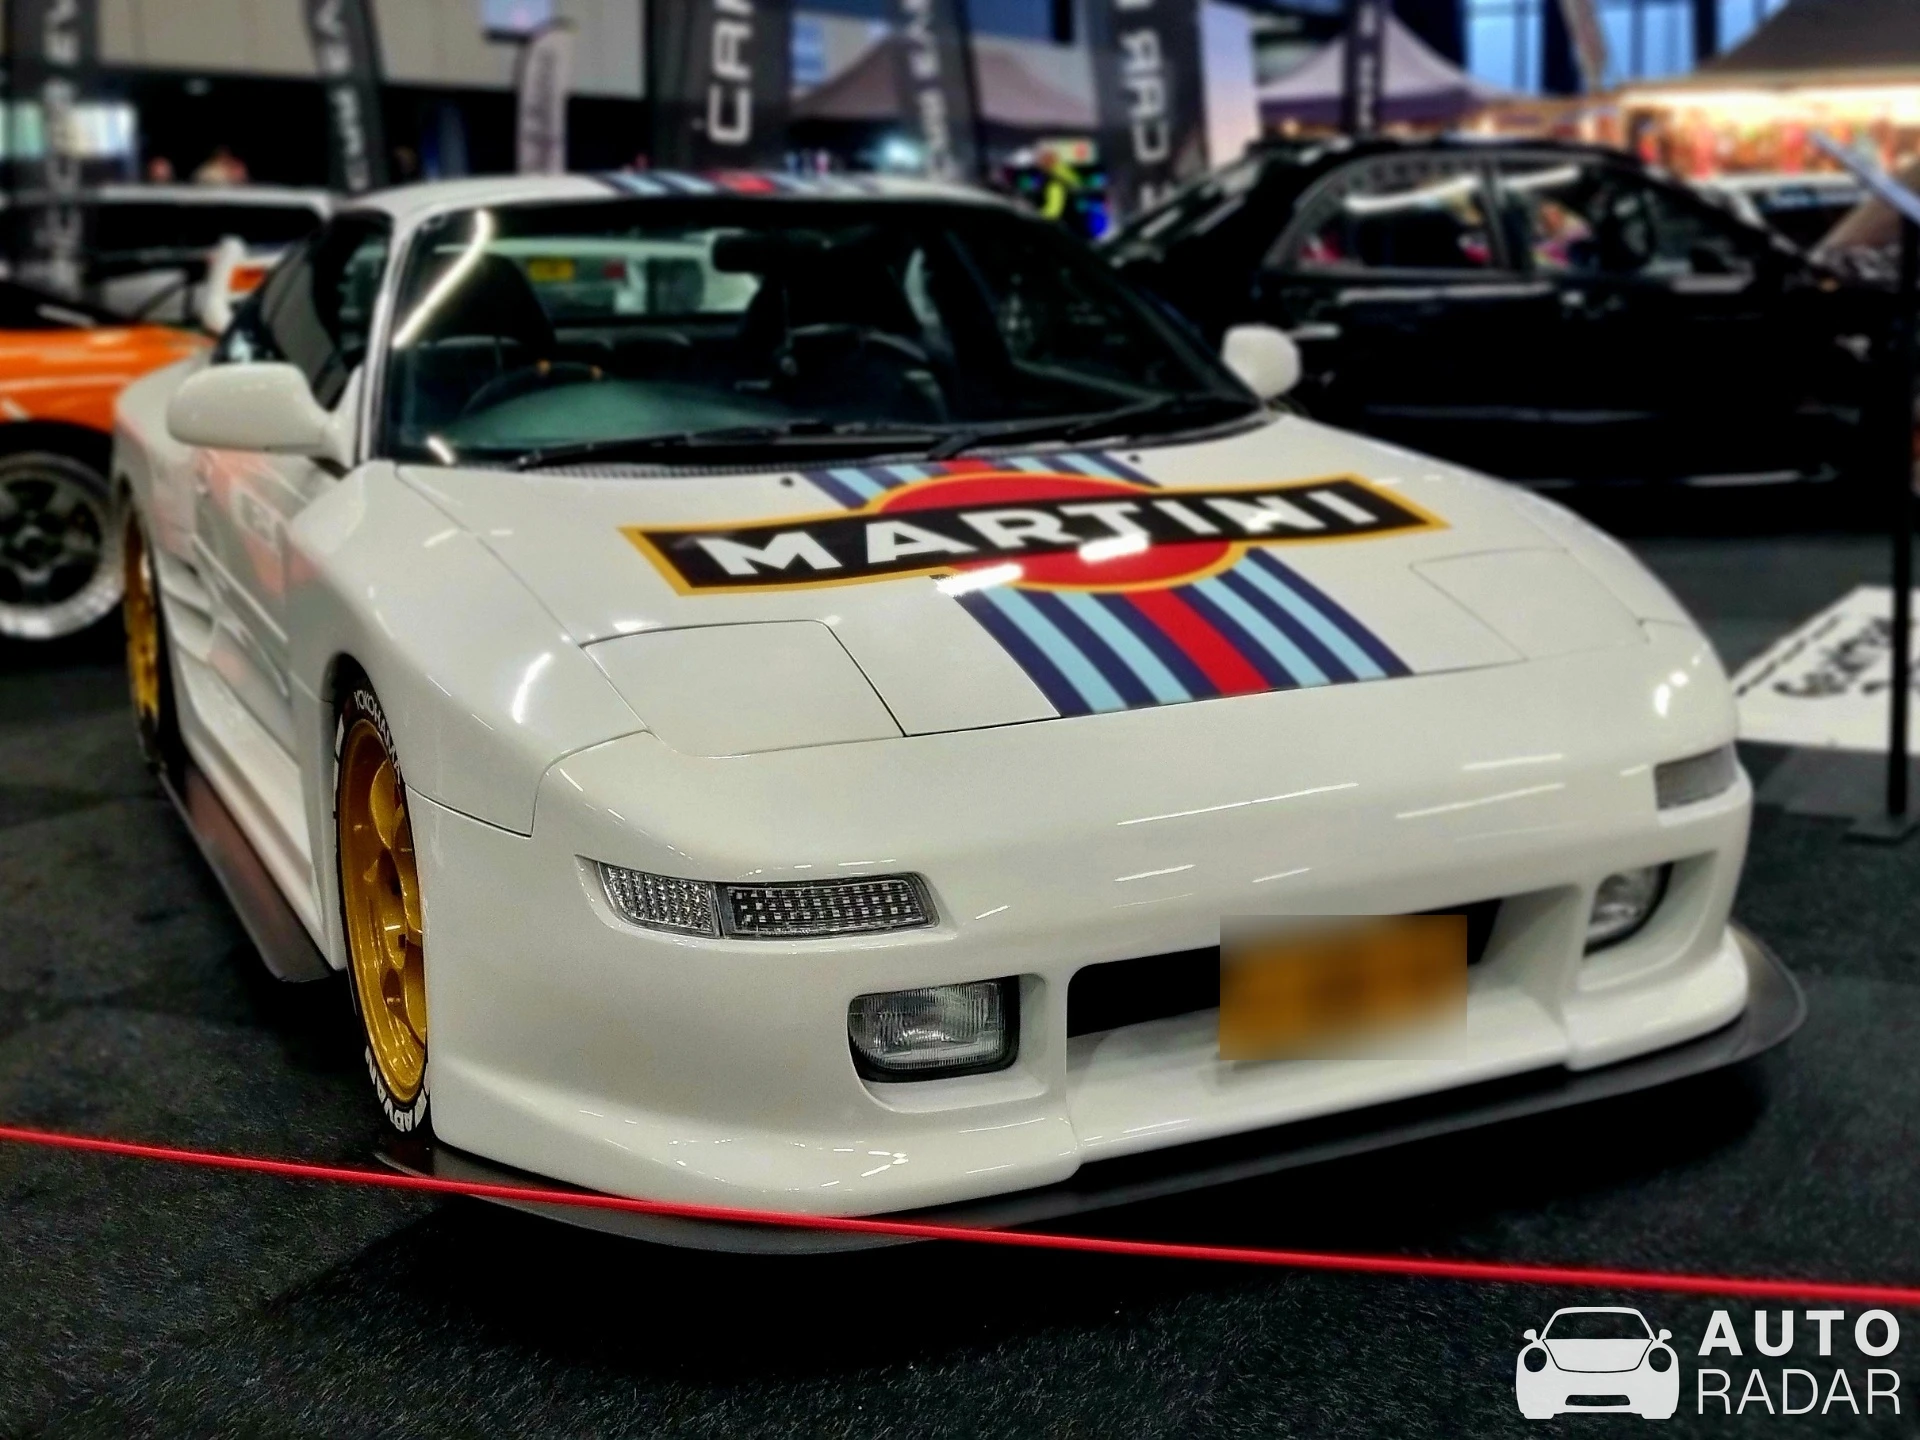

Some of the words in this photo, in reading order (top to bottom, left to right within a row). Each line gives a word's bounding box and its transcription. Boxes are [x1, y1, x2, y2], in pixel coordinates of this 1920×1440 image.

[707, 0, 754, 144] CA
[698, 489, 1380, 577] MARTINI
[353, 688, 401, 785] YOKOHAMA
